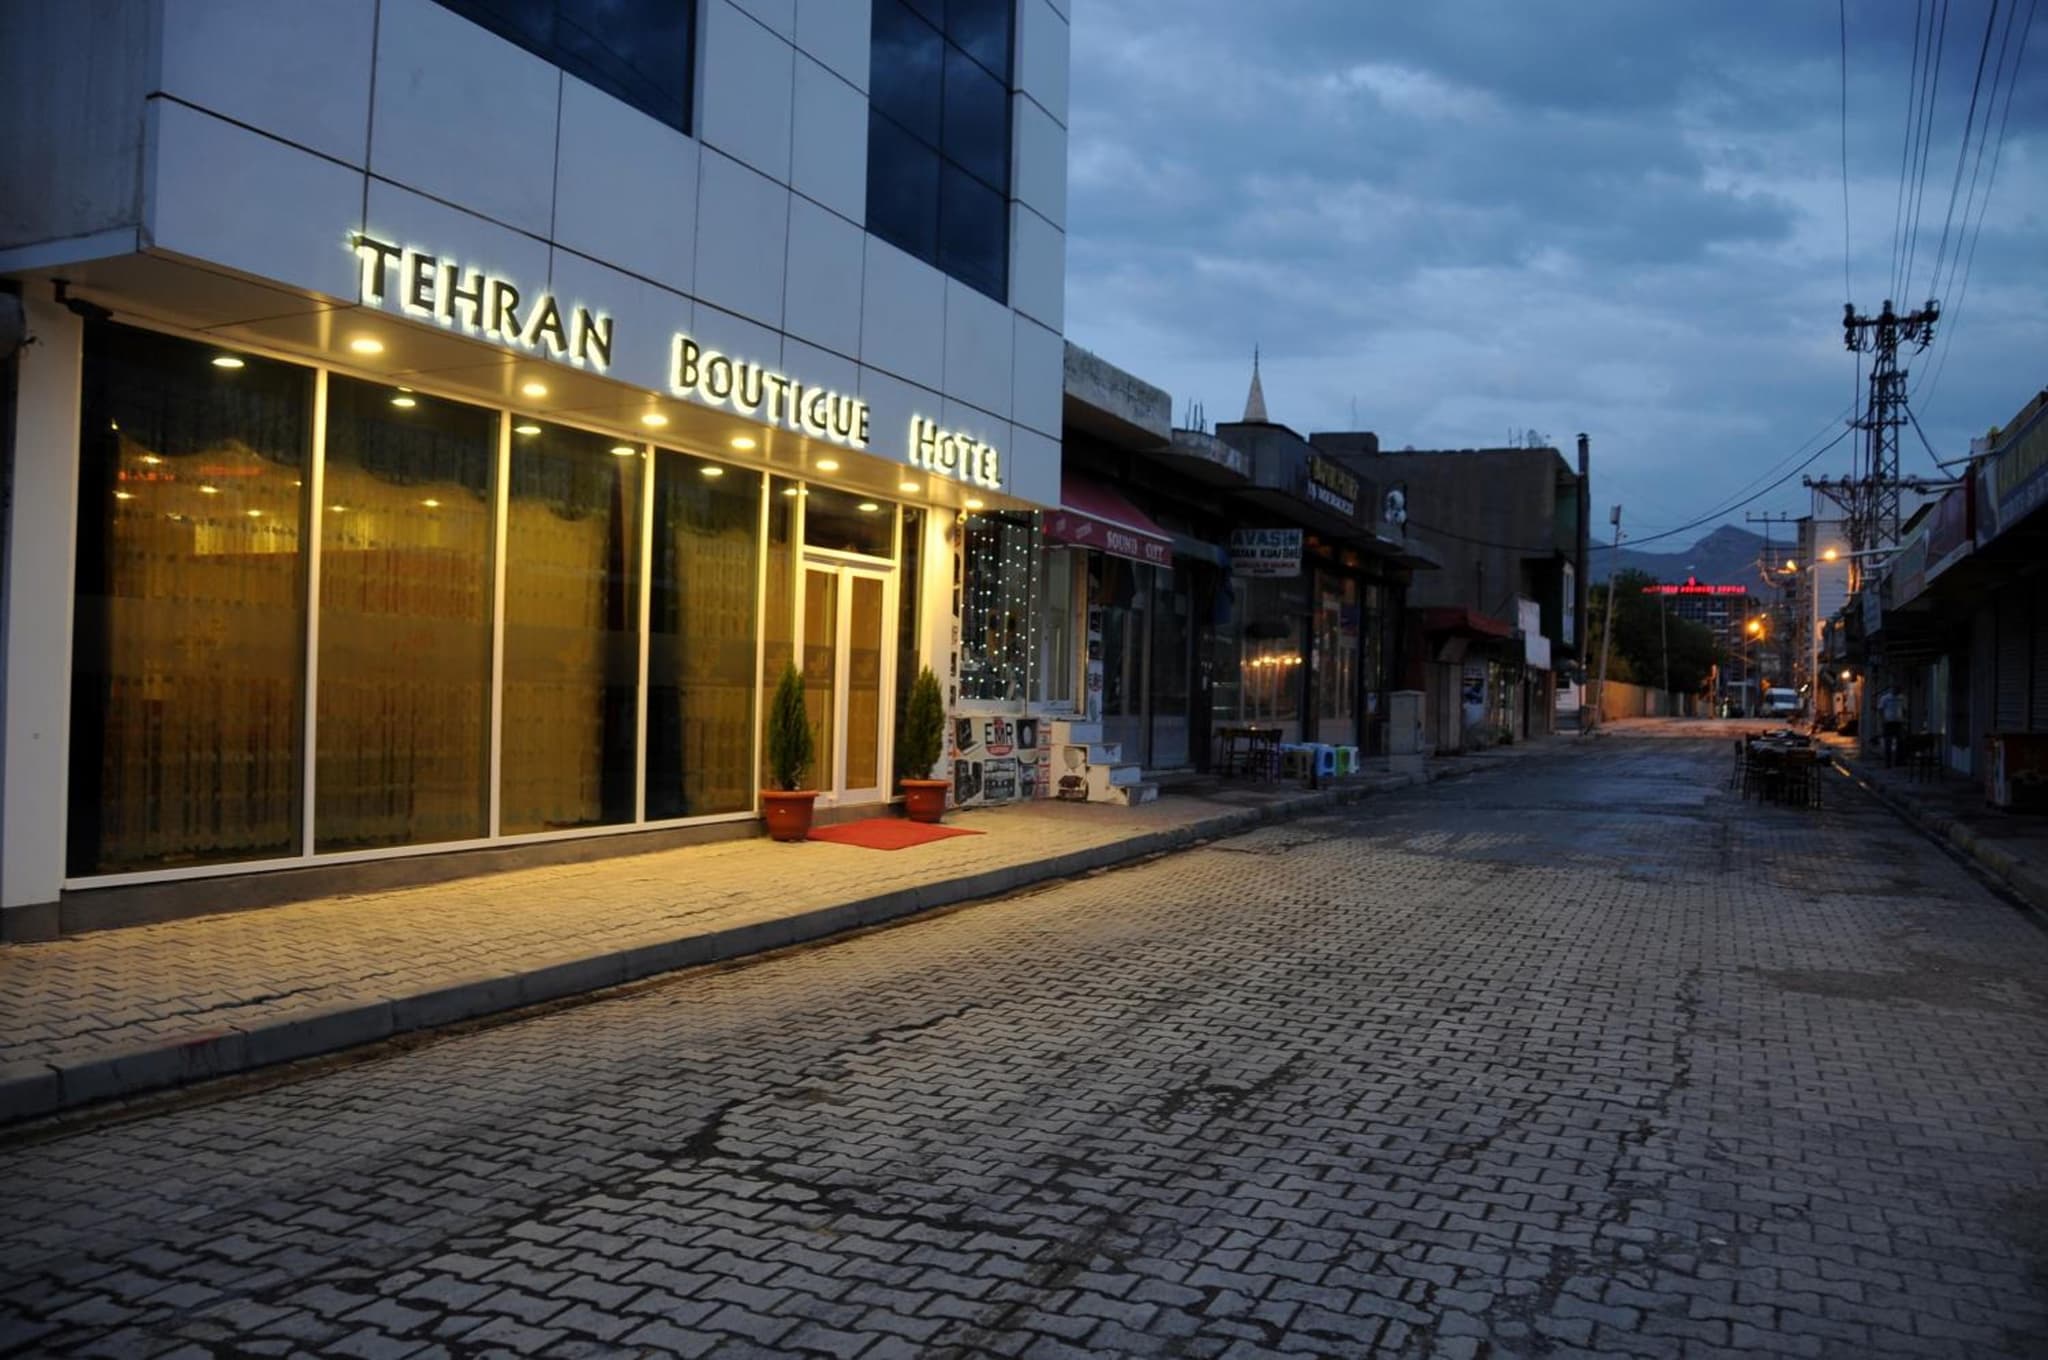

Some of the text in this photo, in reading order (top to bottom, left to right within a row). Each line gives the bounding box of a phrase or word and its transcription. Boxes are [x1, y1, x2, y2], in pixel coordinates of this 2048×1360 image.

[354, 233, 615, 370] TEHRAN
[909, 414, 1001, 488] HOTEL
[1106, 530, 1137, 555] SOUND
